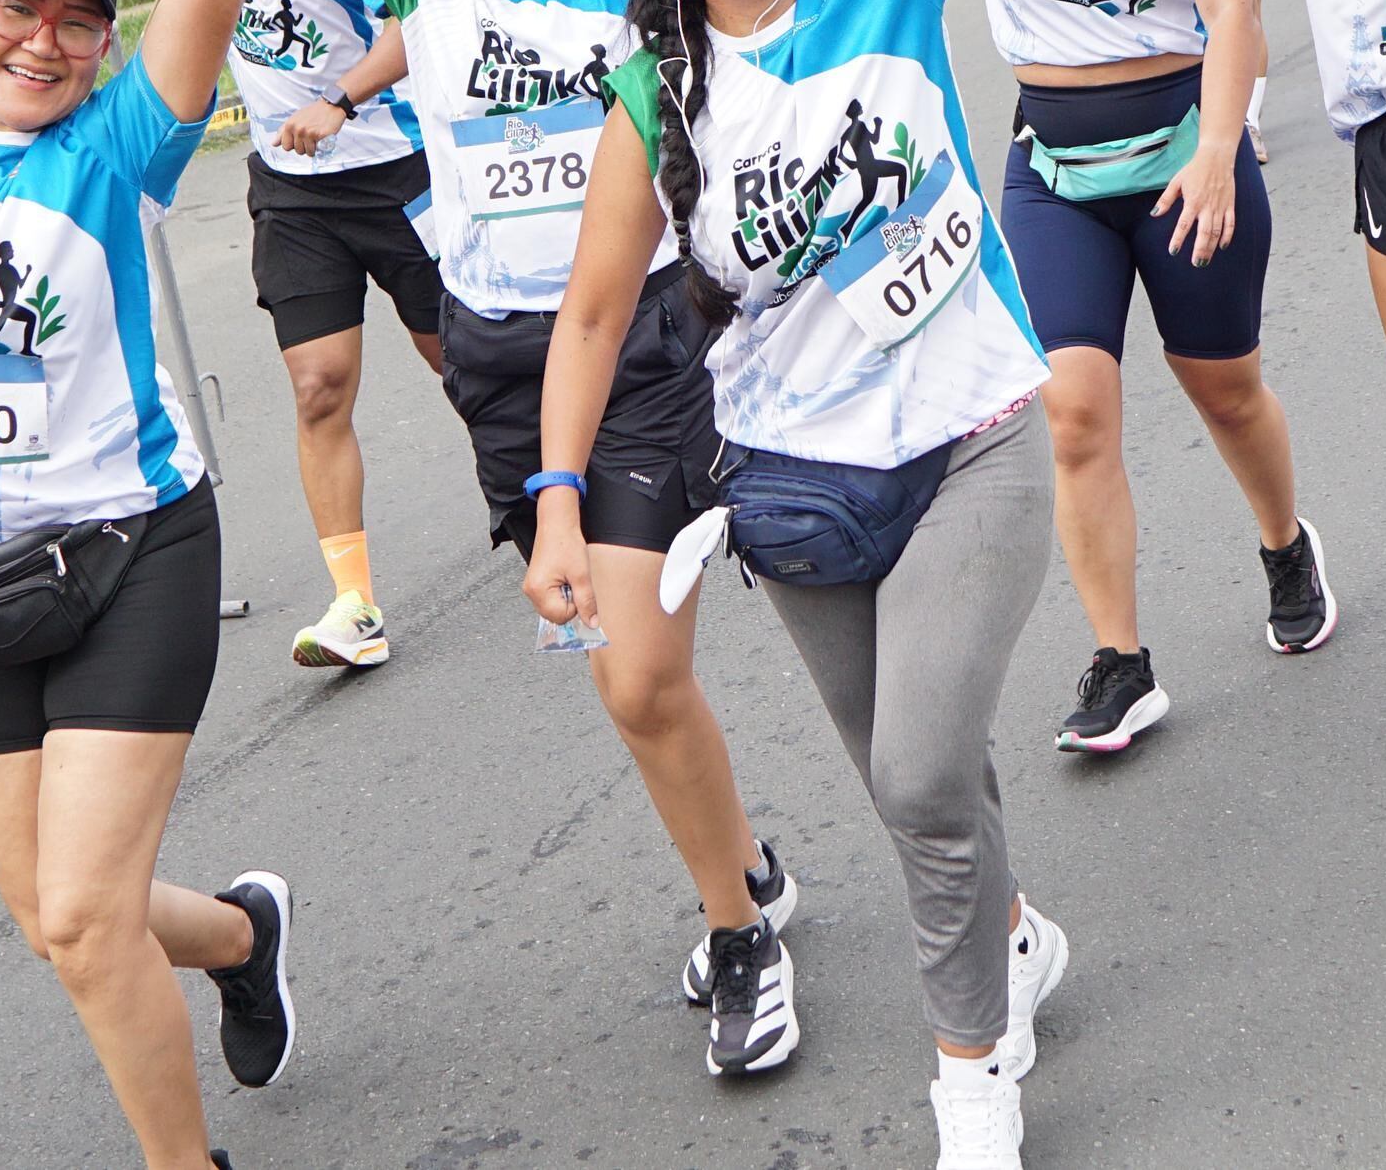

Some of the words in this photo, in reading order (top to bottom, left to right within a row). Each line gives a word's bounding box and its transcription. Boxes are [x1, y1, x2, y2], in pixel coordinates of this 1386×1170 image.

[485, 152, 587, 199] 2378
[734, 153, 805, 221] Río
[883, 211, 972, 317] 0716
